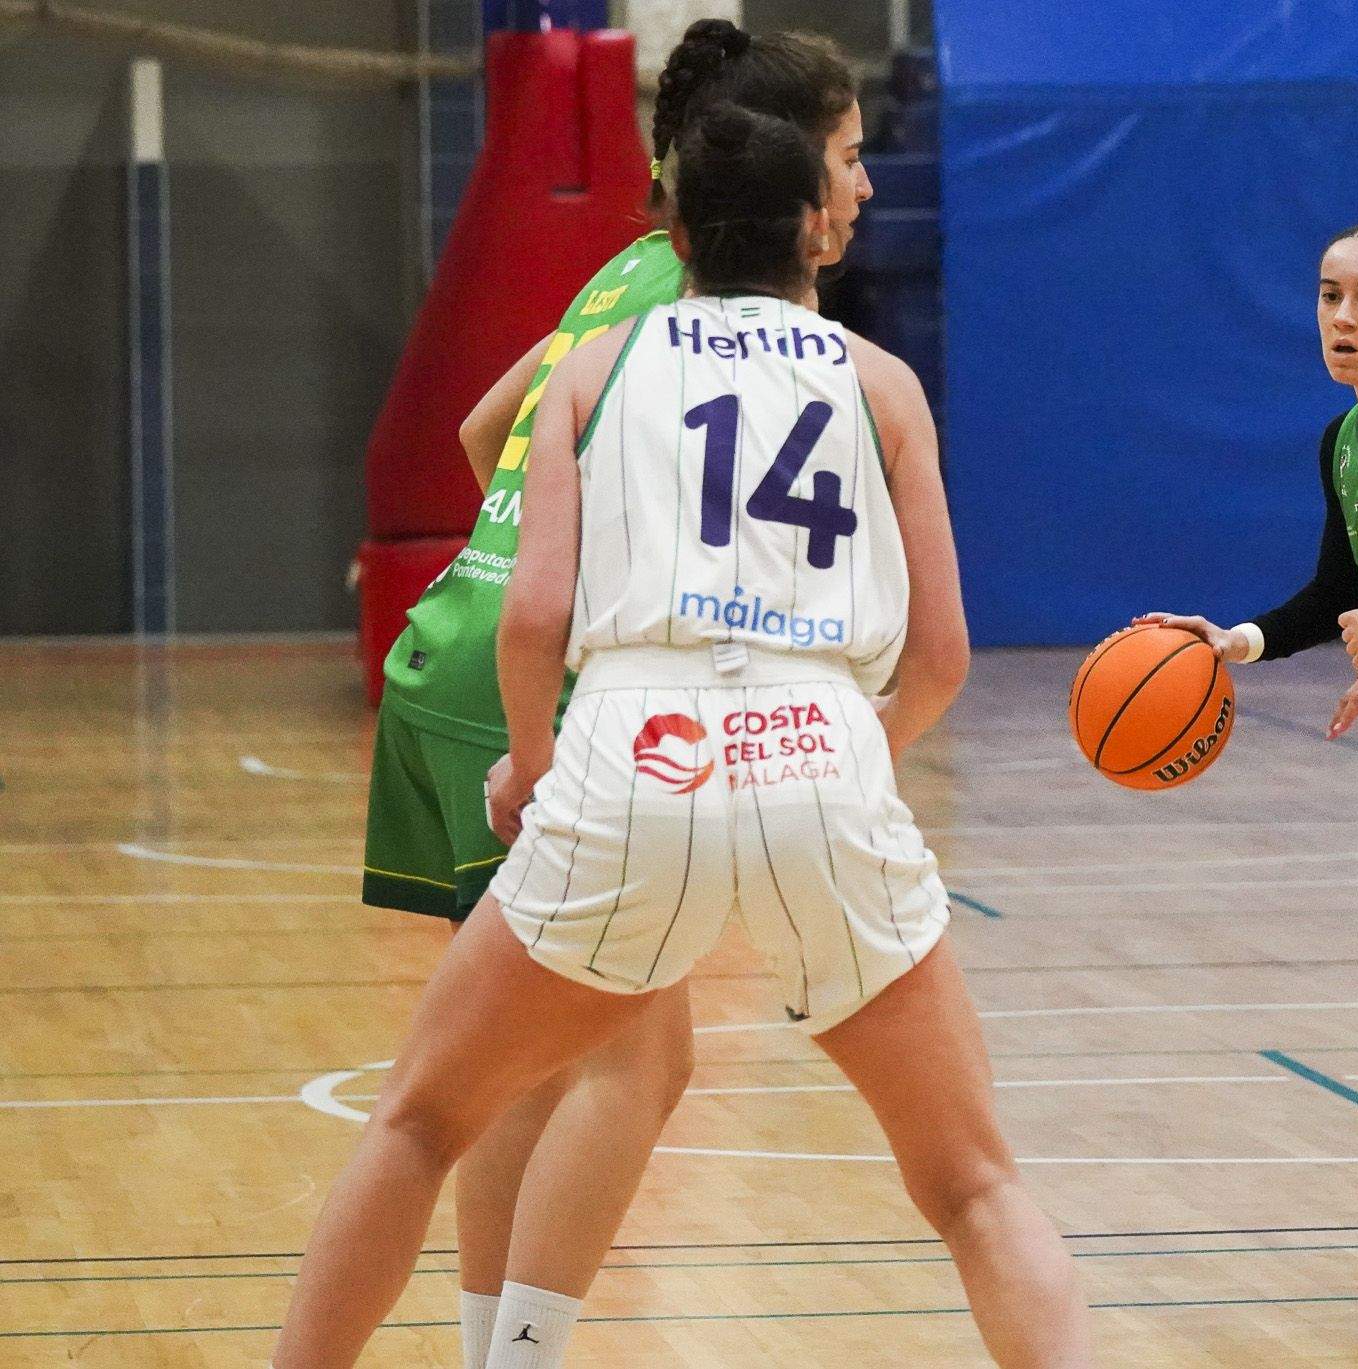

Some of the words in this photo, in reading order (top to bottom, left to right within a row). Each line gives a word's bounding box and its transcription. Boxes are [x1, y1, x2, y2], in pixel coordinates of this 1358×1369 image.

[684, 394, 858, 569] 14
[680, 585, 844, 647] málaga
[722, 702, 831, 736] COSTA
[780, 733, 835, 757] SOL
[1152, 696, 1232, 782] Wilson
